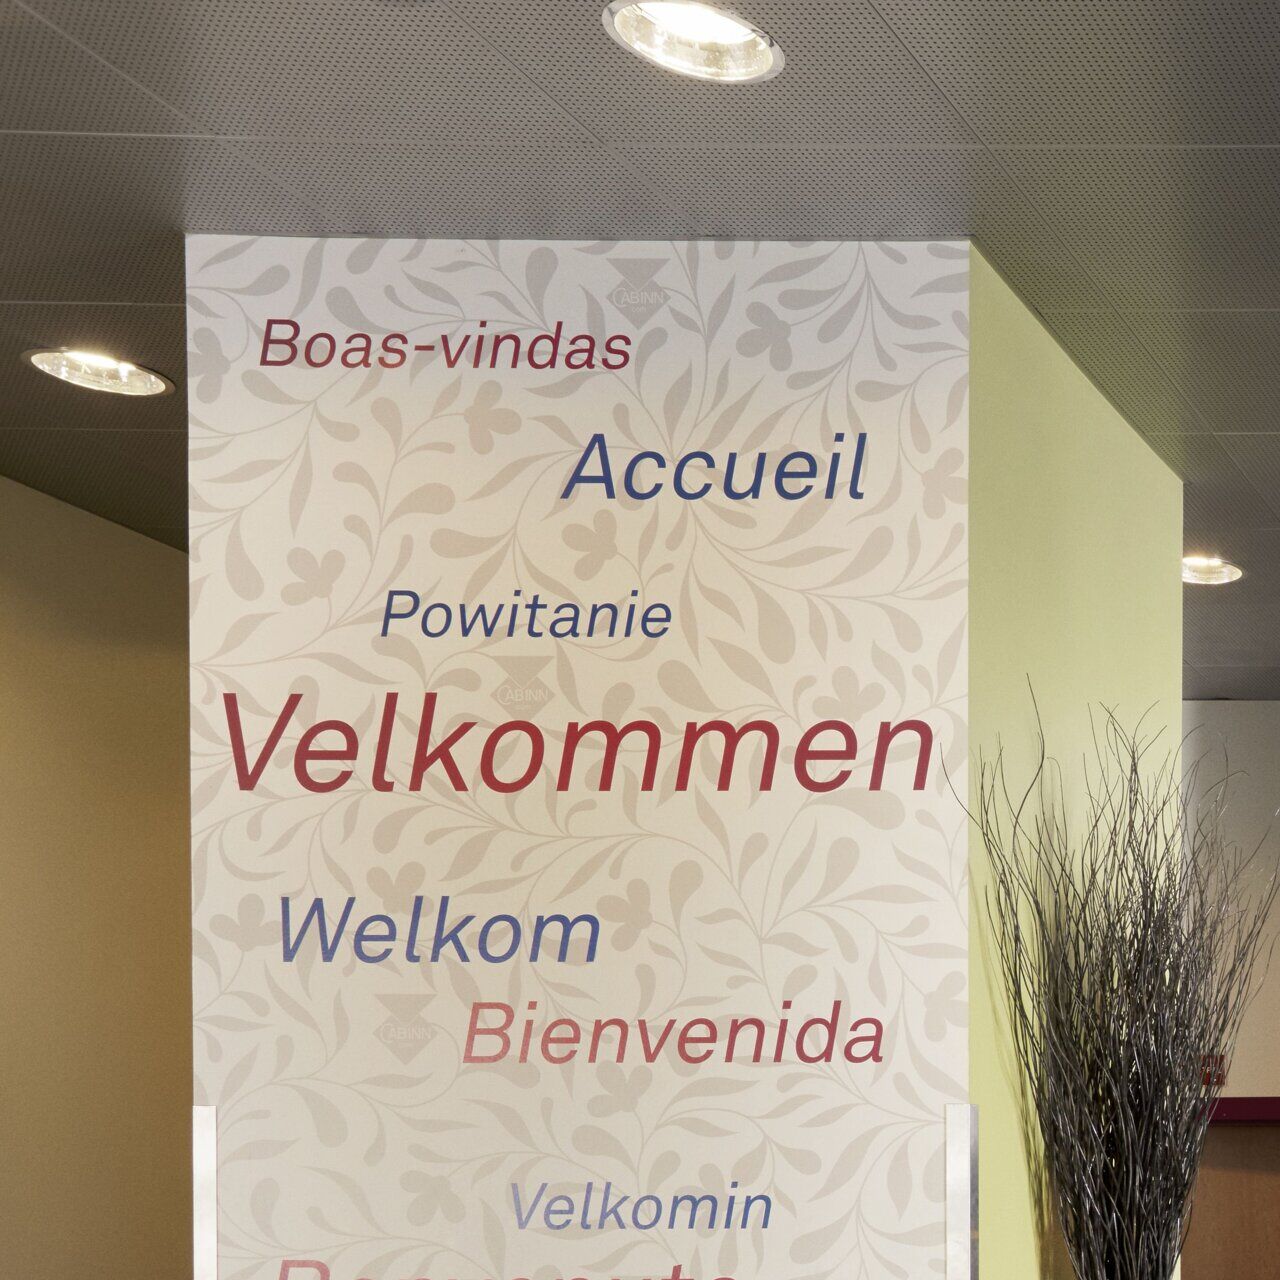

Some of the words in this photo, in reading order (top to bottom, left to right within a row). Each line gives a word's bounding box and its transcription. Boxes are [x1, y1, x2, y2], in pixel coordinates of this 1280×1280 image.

[259, 318, 633, 371] Boas-vindas
[561, 431, 869, 502] Accueil
[380, 588, 673, 641] Powitanie
[222, 691, 934, 795] Velkommen
[279, 894, 601, 965] Welkom
[462, 1000, 885, 1065] Bienvenida
[507, 1181, 773, 1232] Velkomin
